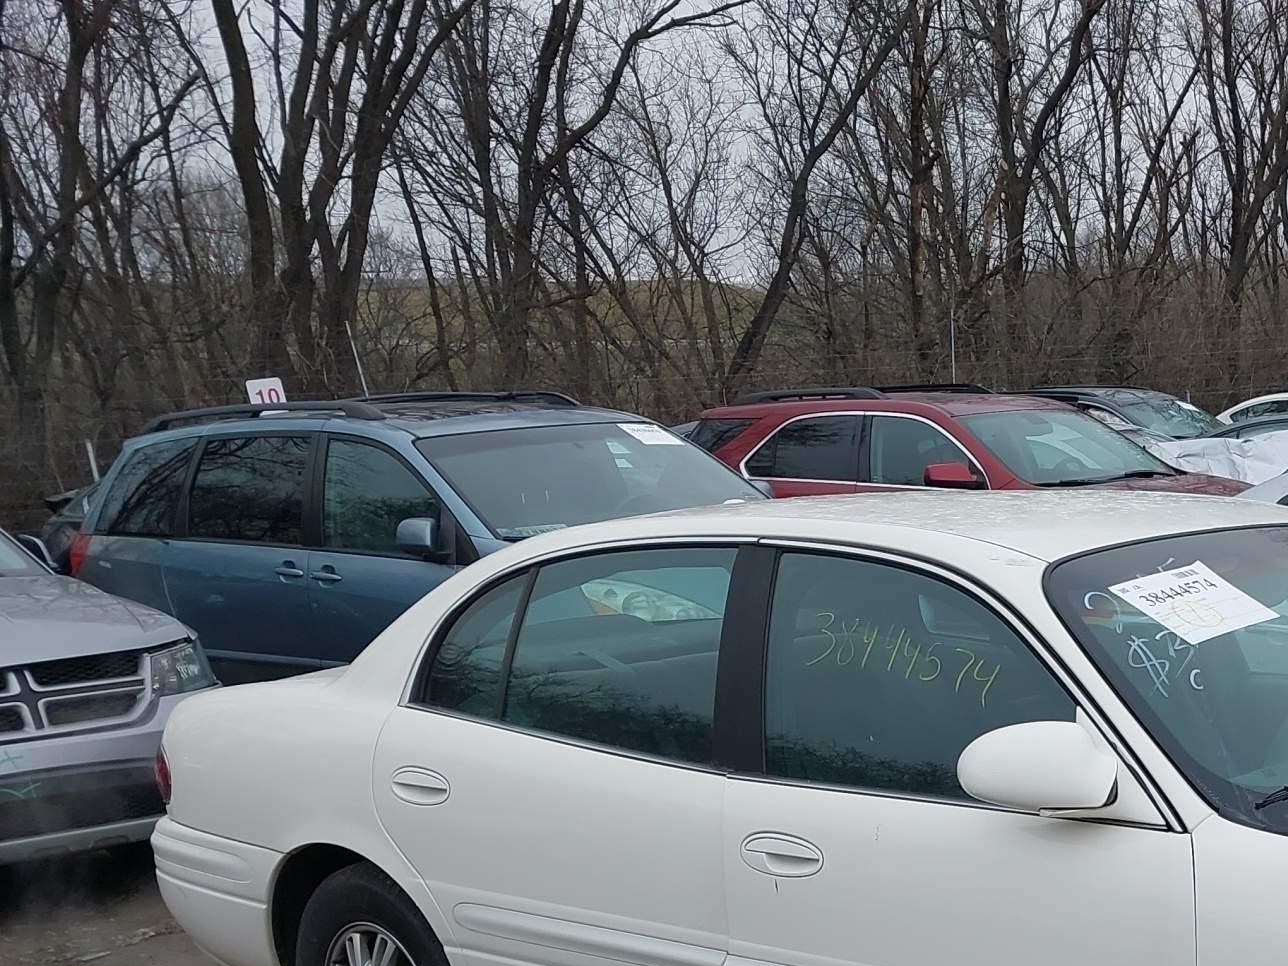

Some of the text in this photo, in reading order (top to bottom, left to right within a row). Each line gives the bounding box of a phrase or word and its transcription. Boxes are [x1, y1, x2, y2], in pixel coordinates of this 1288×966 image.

[255, 387, 281, 404] 10
[1138, 578, 1219, 607] 38444574
[806, 611, 1001, 709] 38444574
